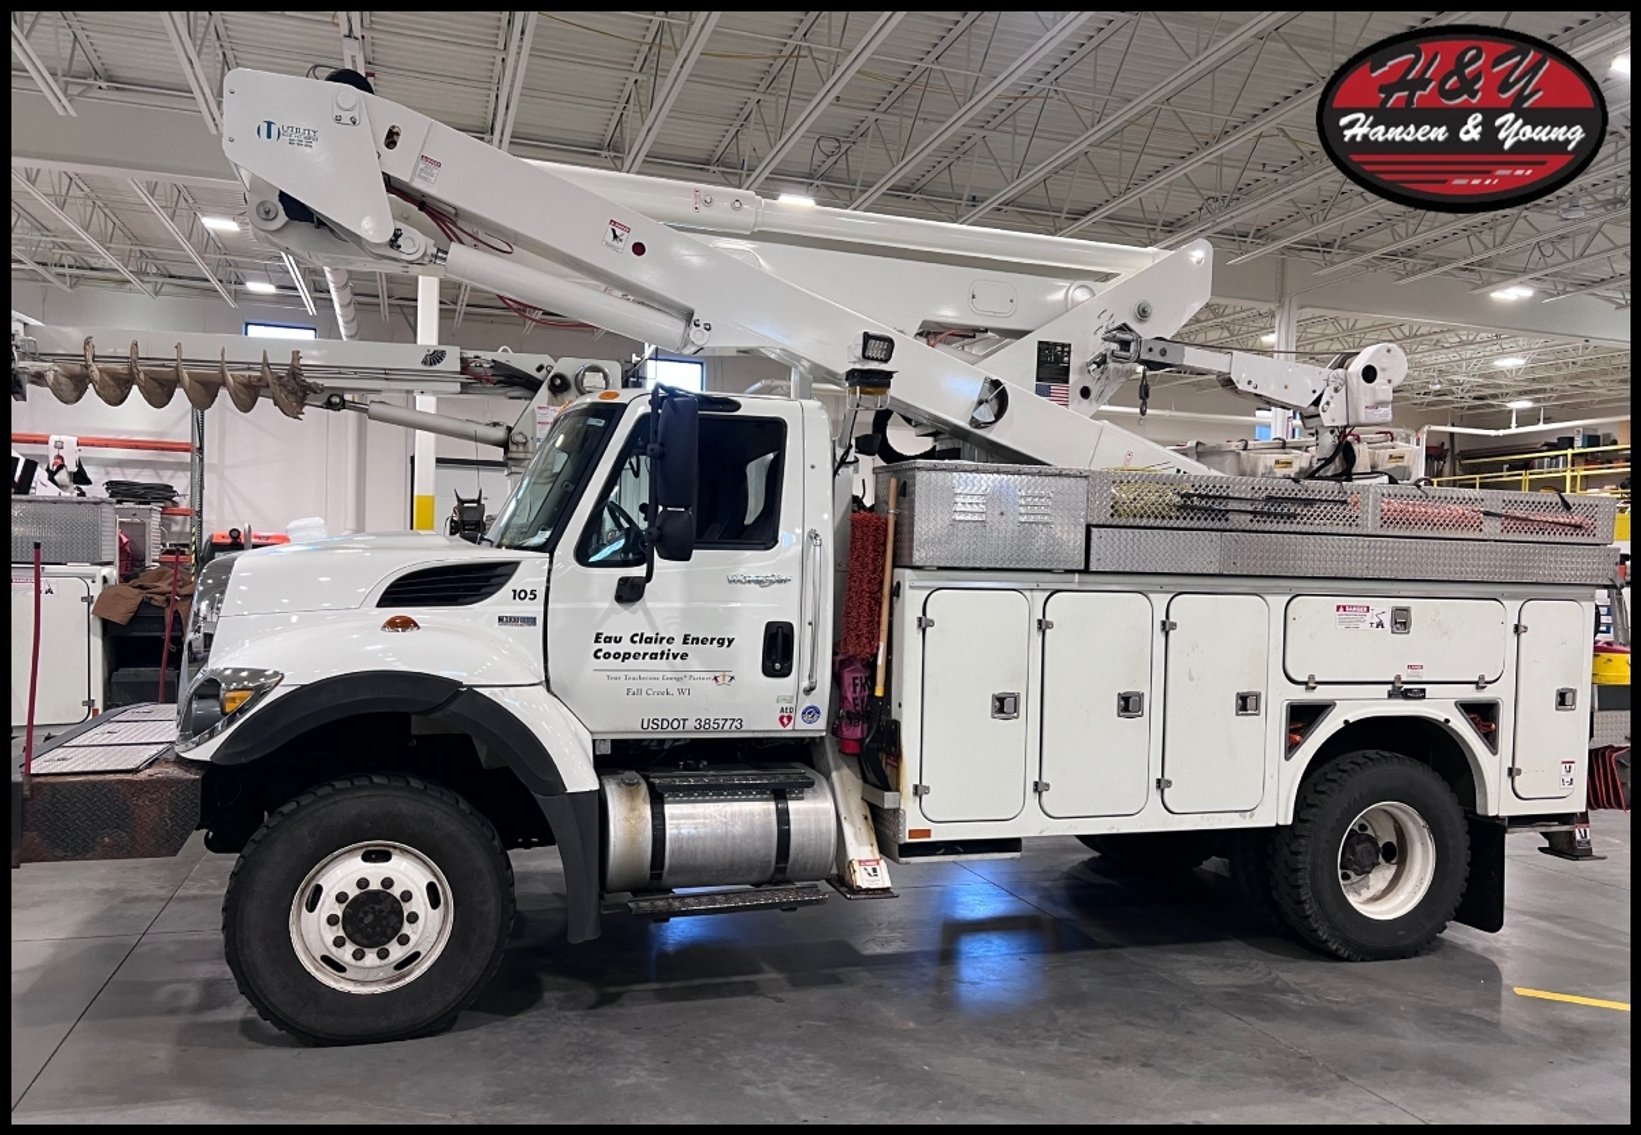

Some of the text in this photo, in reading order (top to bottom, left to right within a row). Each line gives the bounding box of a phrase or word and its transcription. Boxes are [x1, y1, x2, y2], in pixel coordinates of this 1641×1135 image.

[281, 125, 319, 137] UTILITY
[511, 589, 537, 601] 105
[593, 632, 735, 648] Eau Claire Energy
[592, 648, 689, 662] Cooperative
[626, 688, 643, 696] Fall
[676, 688, 691, 696] WI
[640, 718, 744, 731] USDOT 385773
